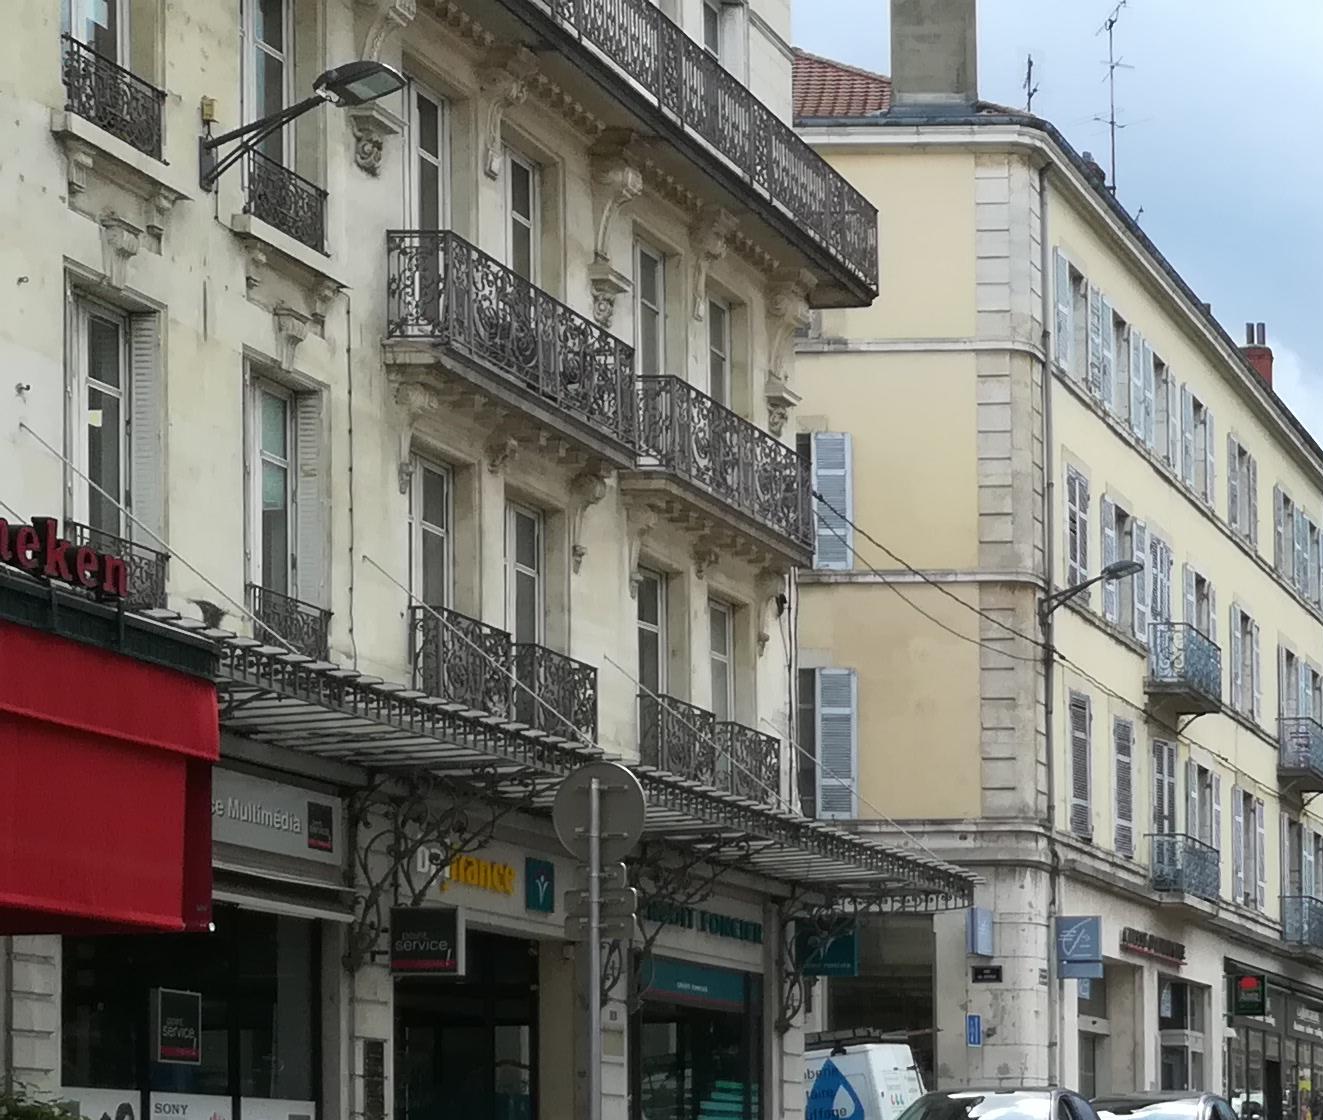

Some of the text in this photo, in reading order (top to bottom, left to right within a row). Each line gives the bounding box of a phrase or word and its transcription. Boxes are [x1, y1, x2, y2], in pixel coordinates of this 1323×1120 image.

[228, 798, 302, 833] Multimédia
[395, 937, 448, 951] service
[162, 1024, 196, 1040] service
[154, 1103, 189, 1117] SONY
